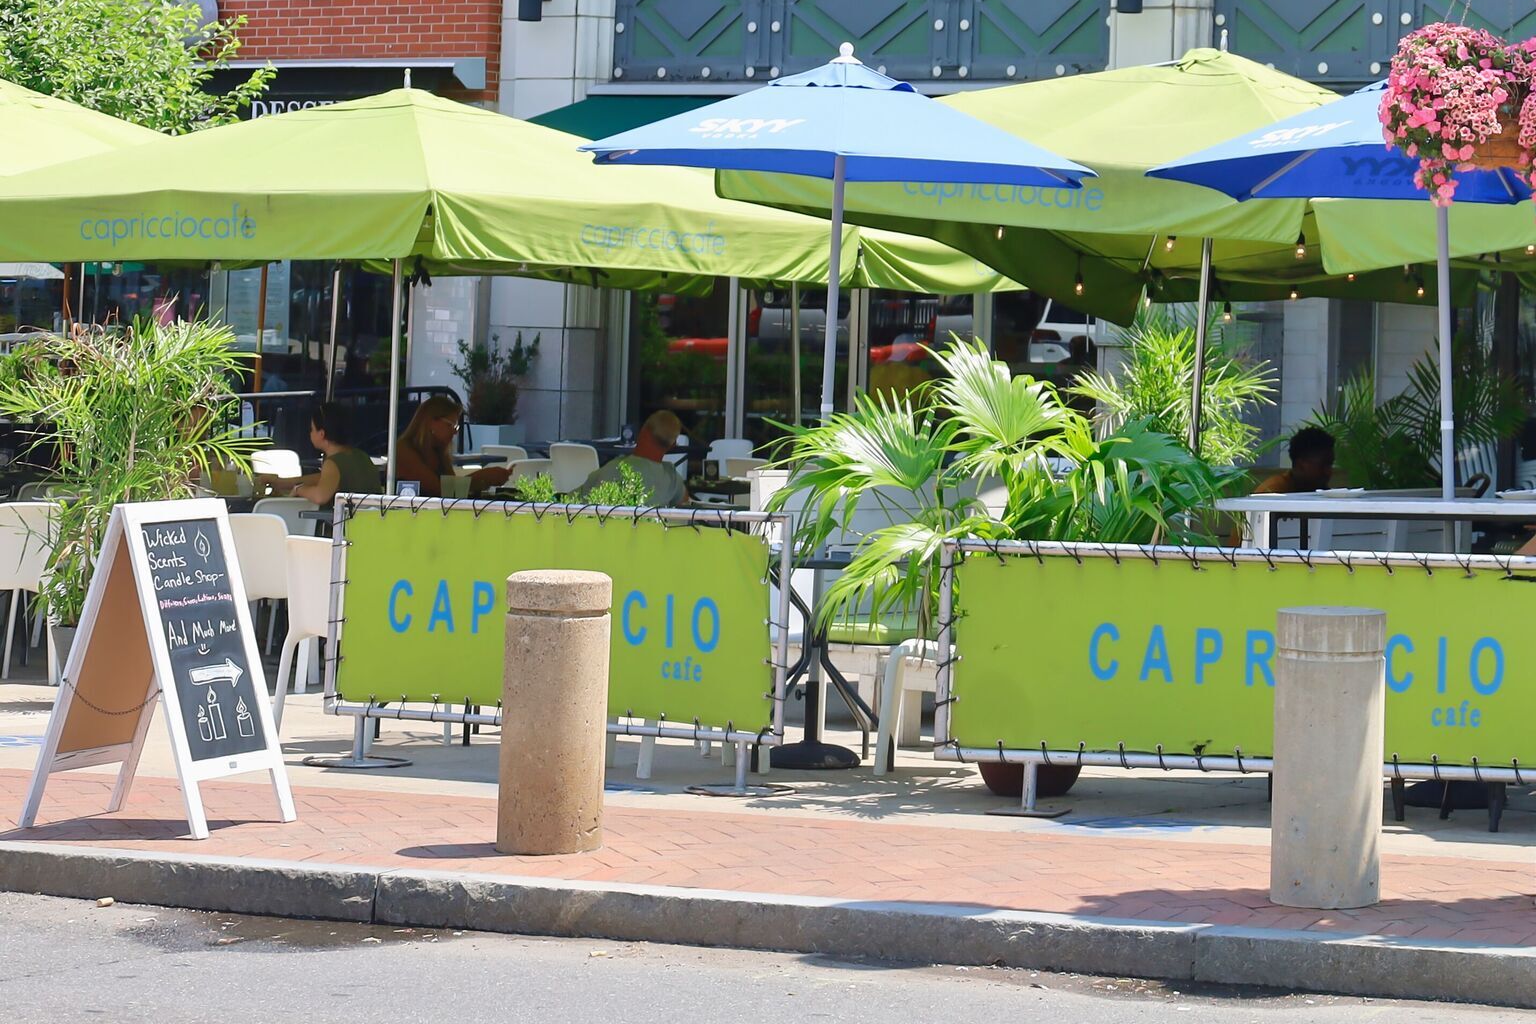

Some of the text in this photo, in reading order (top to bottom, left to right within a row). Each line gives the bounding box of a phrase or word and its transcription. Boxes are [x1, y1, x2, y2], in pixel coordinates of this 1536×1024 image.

[142, 527, 186, 548] Wicked
[148, 551, 187, 570] Scents
[154, 572, 193, 590] Candle
[388, 578, 720, 653] CAPCIO
[168, 619, 237, 650] And Much More
[661, 656, 702, 682] cafe
[1089, 622, 1505, 696] CAPRCIO
[1431, 699, 1481, 728] cafe
